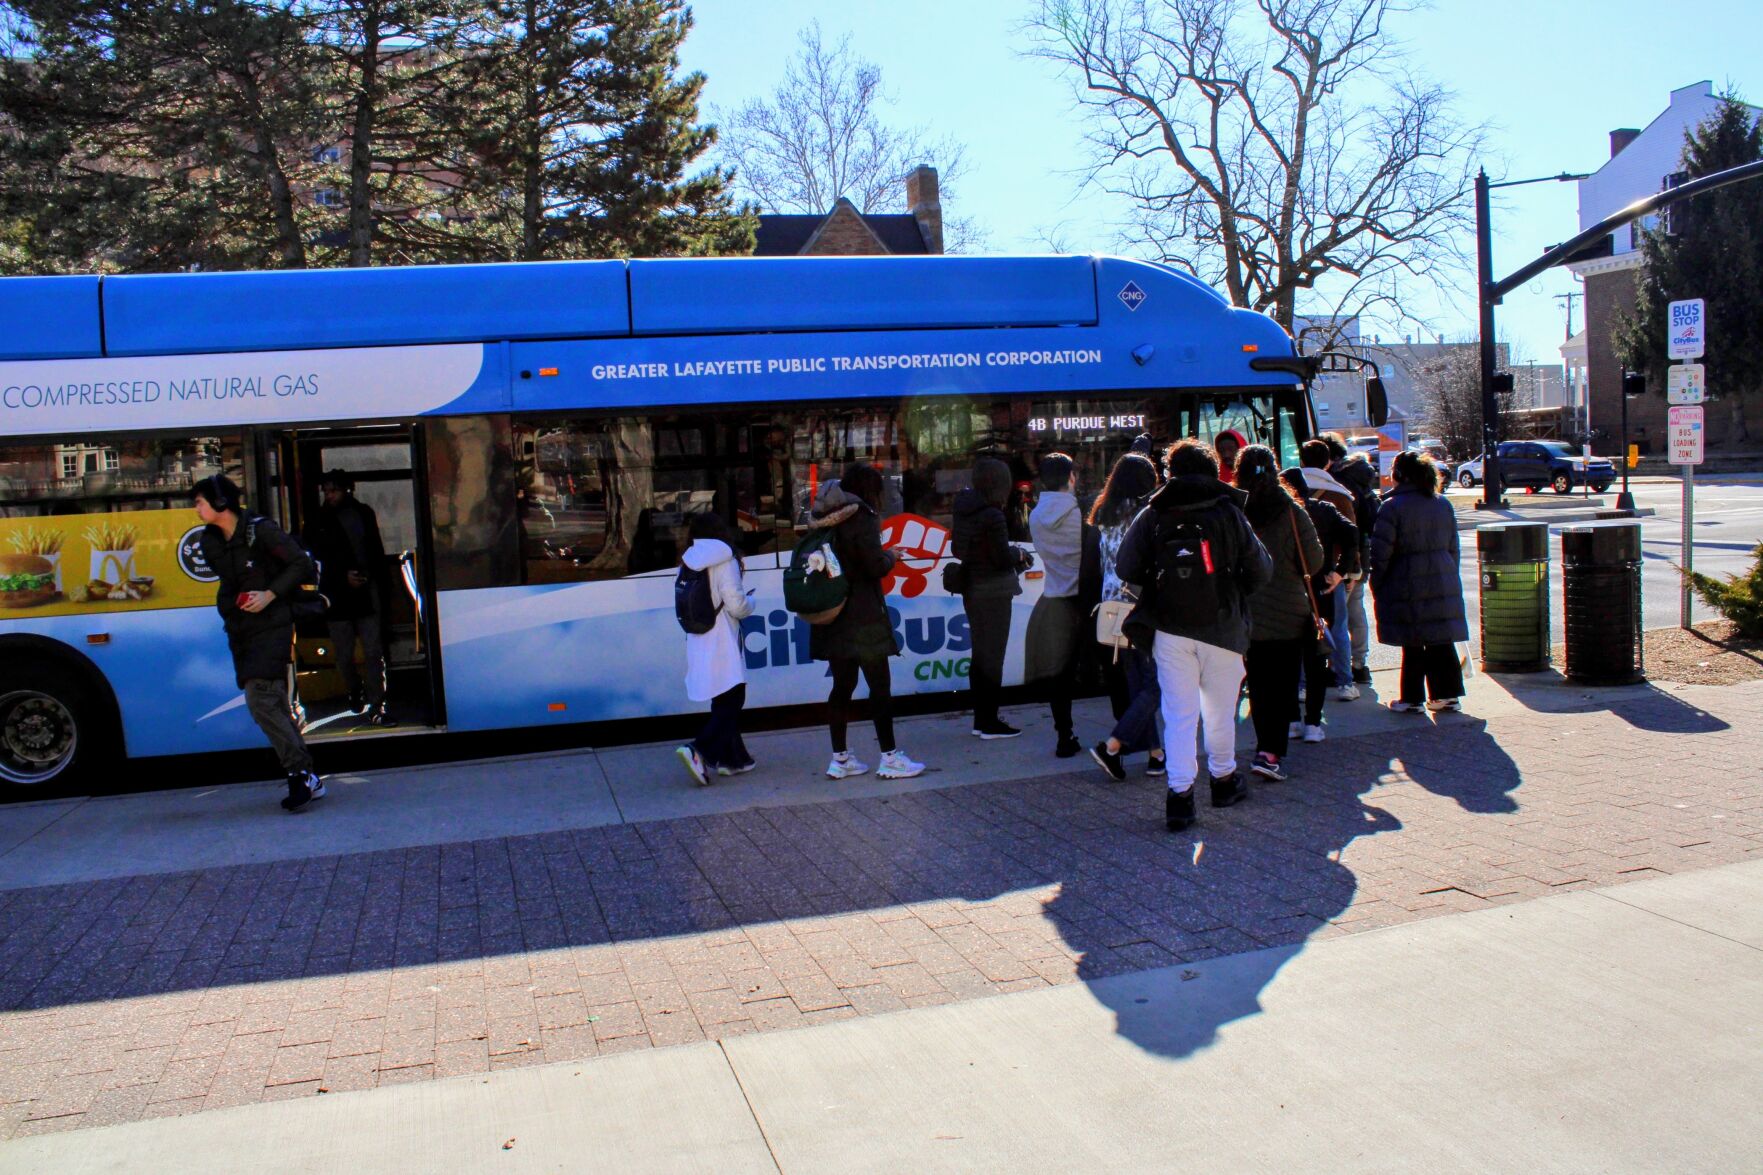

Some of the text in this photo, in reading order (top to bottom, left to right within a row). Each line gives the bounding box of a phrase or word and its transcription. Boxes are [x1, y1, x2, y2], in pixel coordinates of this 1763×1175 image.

[1121, 291, 1142, 300] CNG
[1673, 304, 1699, 317] BUS
[1673, 316, 1699, 326] STOP
[591, 349, 1102, 380] GREATER LAFAYETTE PUBLIC TRANSPORTATION CORPORATION
[3, 373, 319, 408] COMPRESSED NATURAL GAS
[1027, 415, 1145, 431] 4B PURDUE WEST
[1673, 439, 1697, 447] LOADING
[1678, 450, 1693, 458] ZONE
[914, 657, 972, 681] CNG
